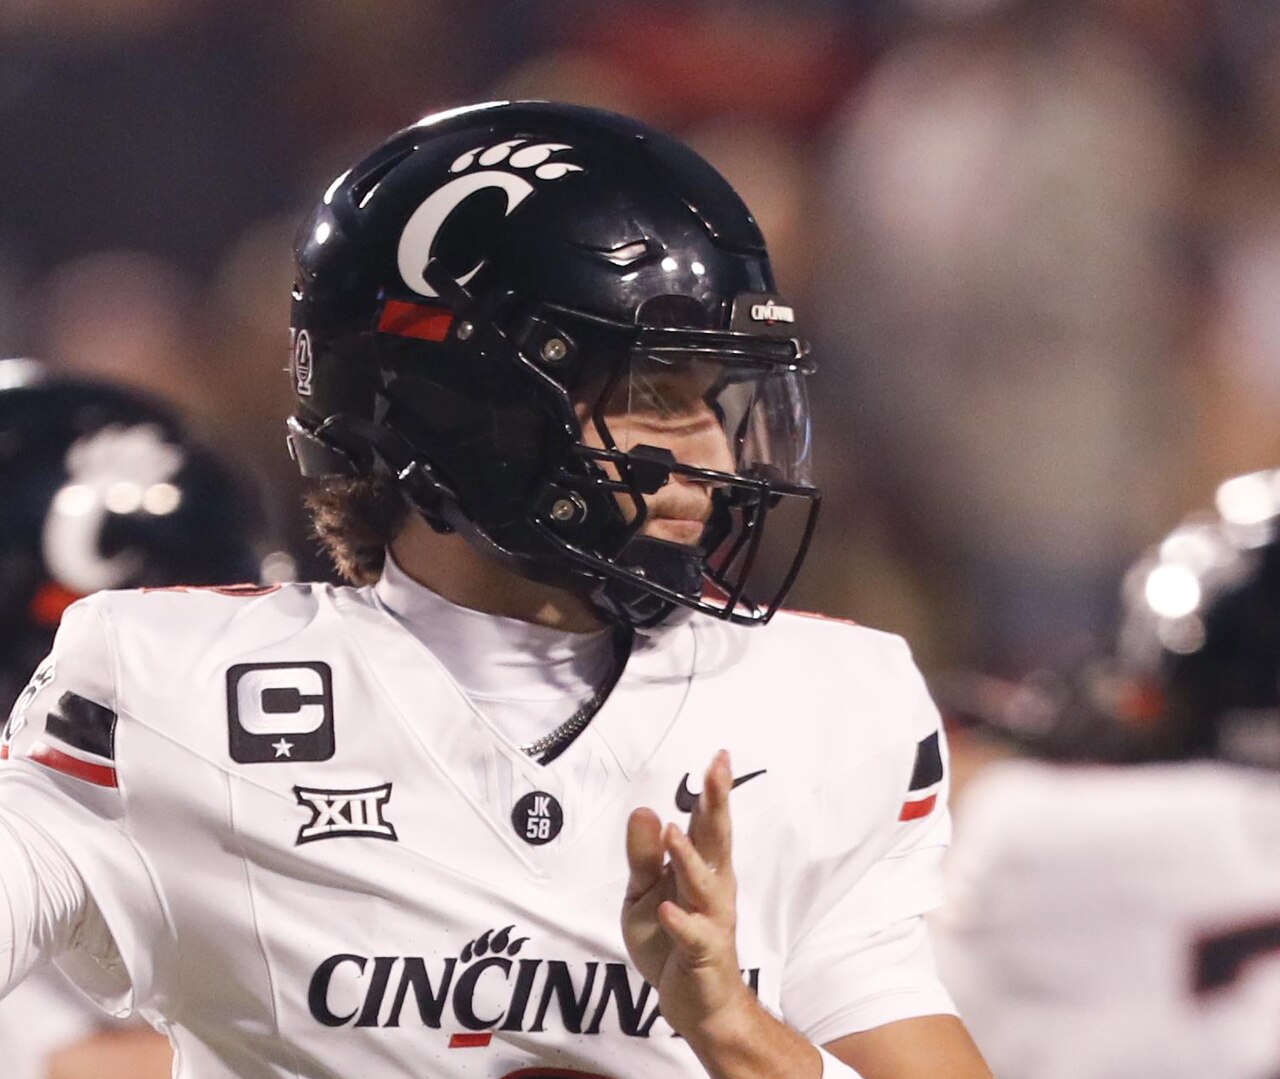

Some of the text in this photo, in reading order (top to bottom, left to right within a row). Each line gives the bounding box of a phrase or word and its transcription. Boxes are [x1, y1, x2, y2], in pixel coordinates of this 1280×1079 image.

[236, 667, 325, 735] C
[297, 786, 394, 840] XII
[526, 817, 551, 839] 58
[527, 796, 551, 817] JK
[308, 952, 760, 1039] CINCINN
